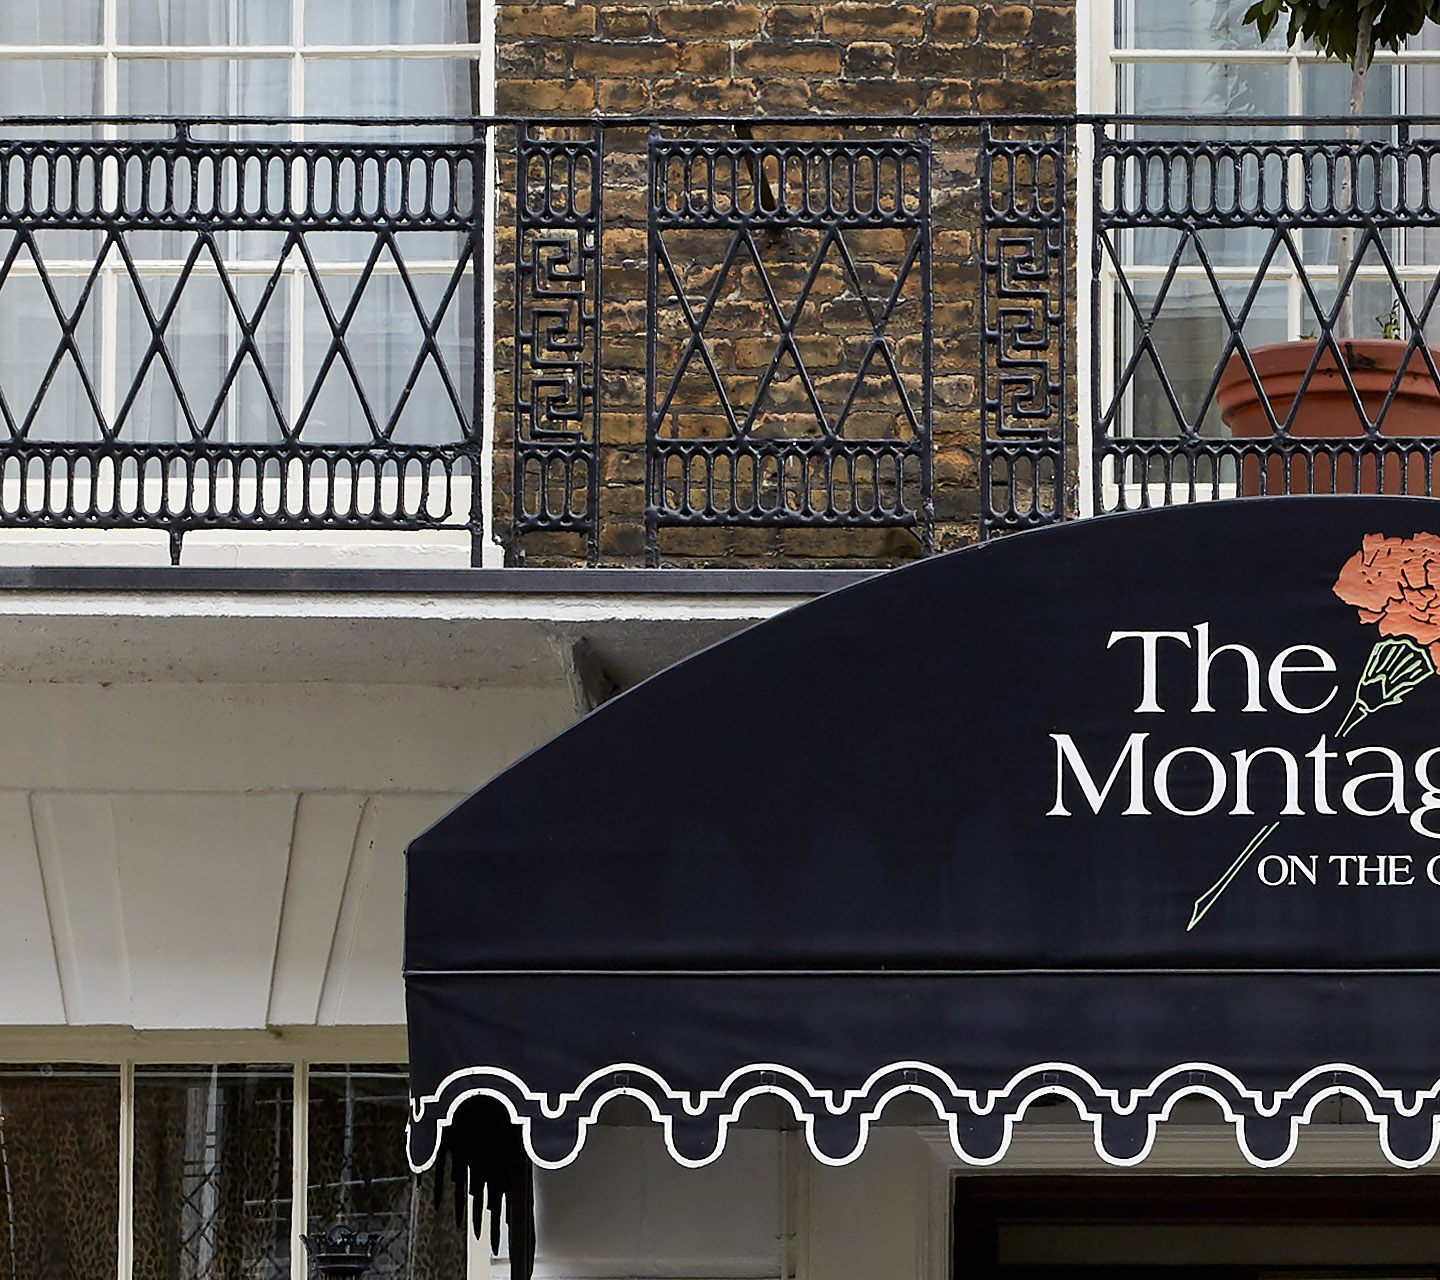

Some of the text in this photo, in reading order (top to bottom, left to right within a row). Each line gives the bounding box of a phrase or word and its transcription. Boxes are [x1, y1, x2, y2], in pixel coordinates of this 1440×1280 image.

[1106, 622, 1338, 714] The
[1257, 854, 1317, 887] ON
[1329, 854, 1415, 887] THE
